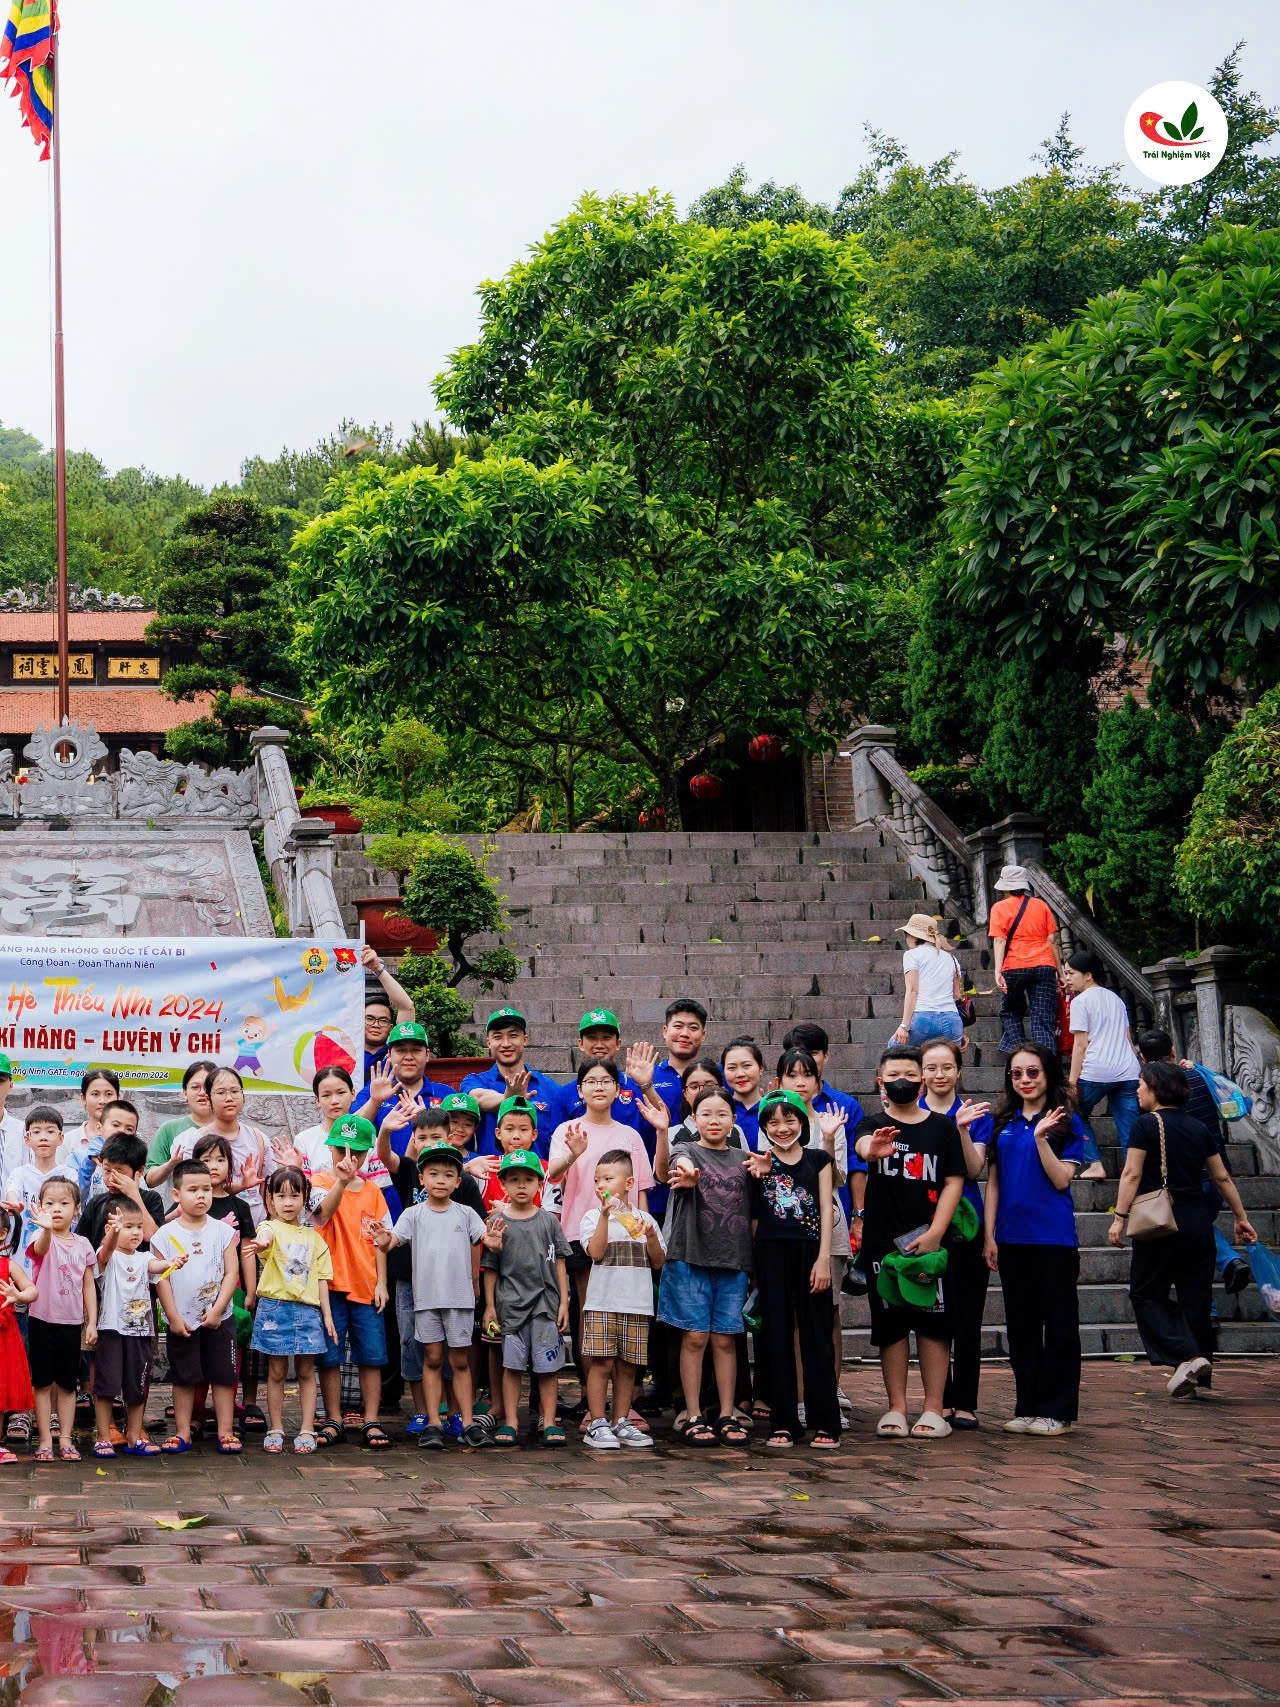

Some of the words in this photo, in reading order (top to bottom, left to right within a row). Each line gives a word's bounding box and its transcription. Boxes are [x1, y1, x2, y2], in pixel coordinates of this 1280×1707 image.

[60, 946, 100, 955] KHÔNG
[102, 945, 135, 956] QUỐC
[138, 945, 150, 956] TẾ
[152, 946, 173, 956] CÁT
[175, 948, 185, 957] BI
[19, 957, 44, 968] Công
[46, 958, 70, 967] Đoàn
[78, 959, 102, 968] Đoàn
[104, 960, 132, 969] Thanh
[134, 960, 155, 969] Niên
[7, 984, 37, 1022] Hè
[44, 978, 105, 1015] Thiếu
[111, 984, 153, 1019] Nhi
[23, 1024, 76, 1050] NĂNG
[102, 1027, 163, 1057] LUYỆN
[170, 1028, 182, 1053] Ý
[187, 1028, 222, 1054] CHÍ
[28, 1067, 46, 1076] Ninh
[47, 1068, 69, 1077] GATE,
[70, 1070, 87, 1078] ngà
[125, 1070, 131, 1078] 8
[131, 1071, 149, 1079] năm
[149, 1071, 170, 1079] 2024
